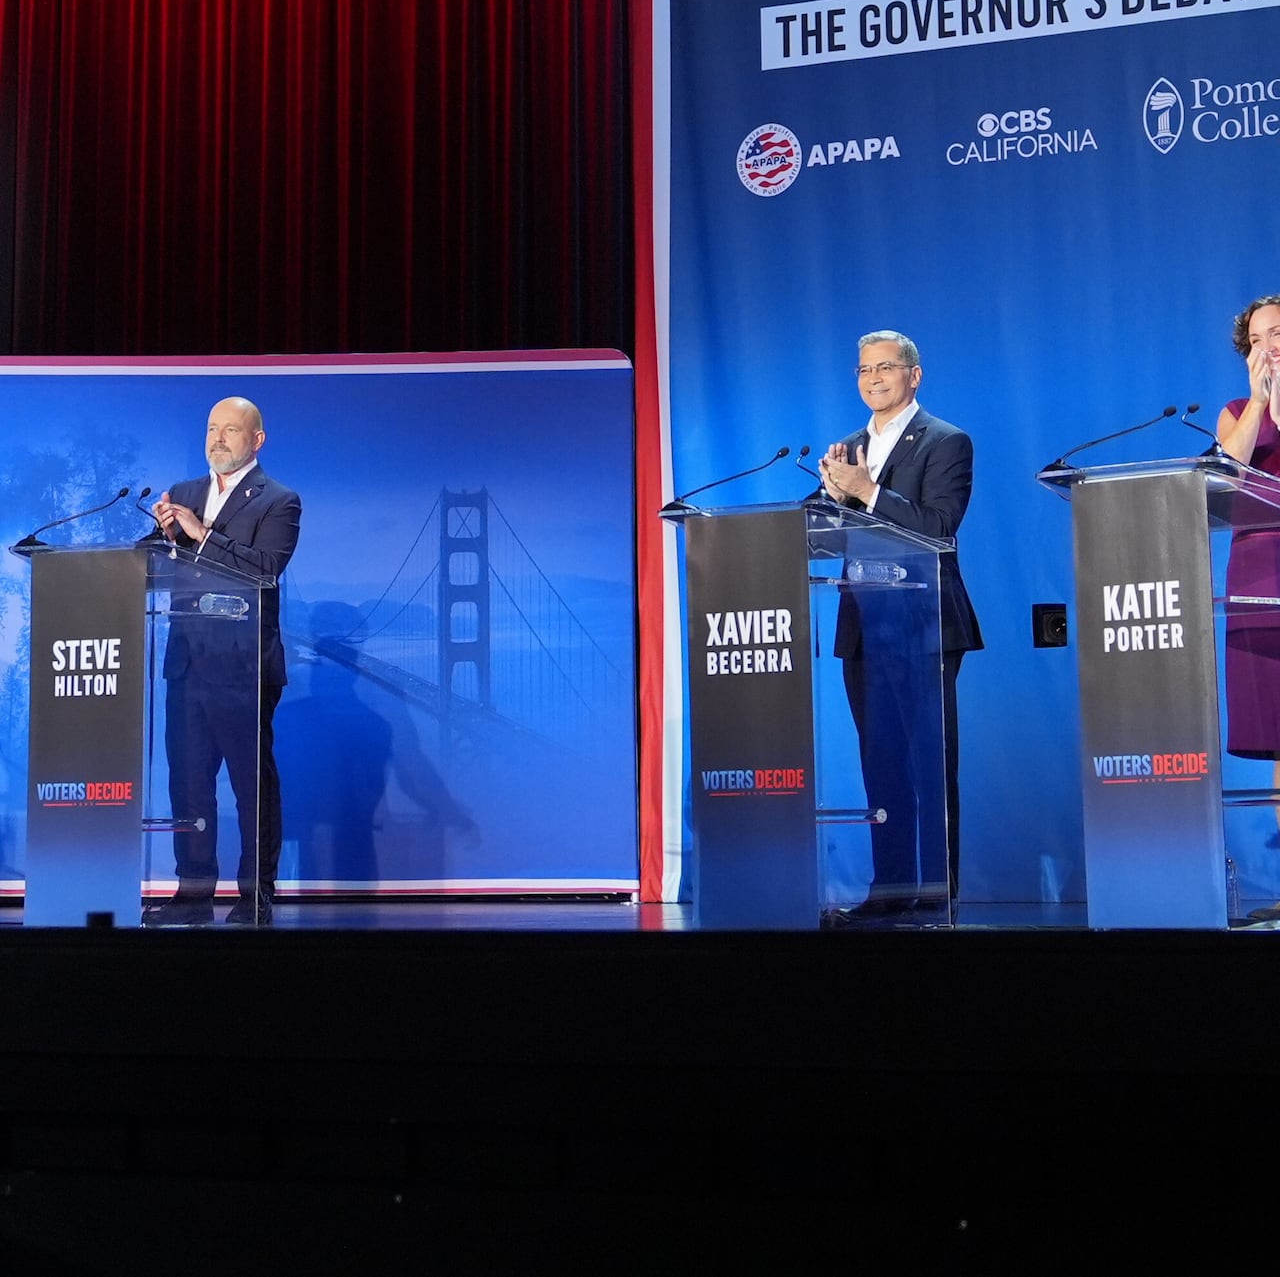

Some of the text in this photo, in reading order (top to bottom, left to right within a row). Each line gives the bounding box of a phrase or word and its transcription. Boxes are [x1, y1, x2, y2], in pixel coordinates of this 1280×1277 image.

[775, 8, 847, 59] THE
[999, 107, 1053, 134] CBS
[752, 155, 787, 168] APAPA
[806, 136, 901, 167] APAPA
[946, 128, 1098, 166] CALIFORNIA
[1102, 579, 1182, 622] KATIE
[705, 608, 792, 647] XAVIER
[1103, 622, 1185, 653] PORTER
[52, 638, 121, 672] STEVE
[706, 648, 793, 675] BECERRA
[54, 673, 117, 697] HILTON
[701, 768, 805, 791] VOTERS DECIDE
[1092, 752, 1209, 778] VOTERS DECIDE
[36, 781, 133, 802] VOTERS DECIDE
